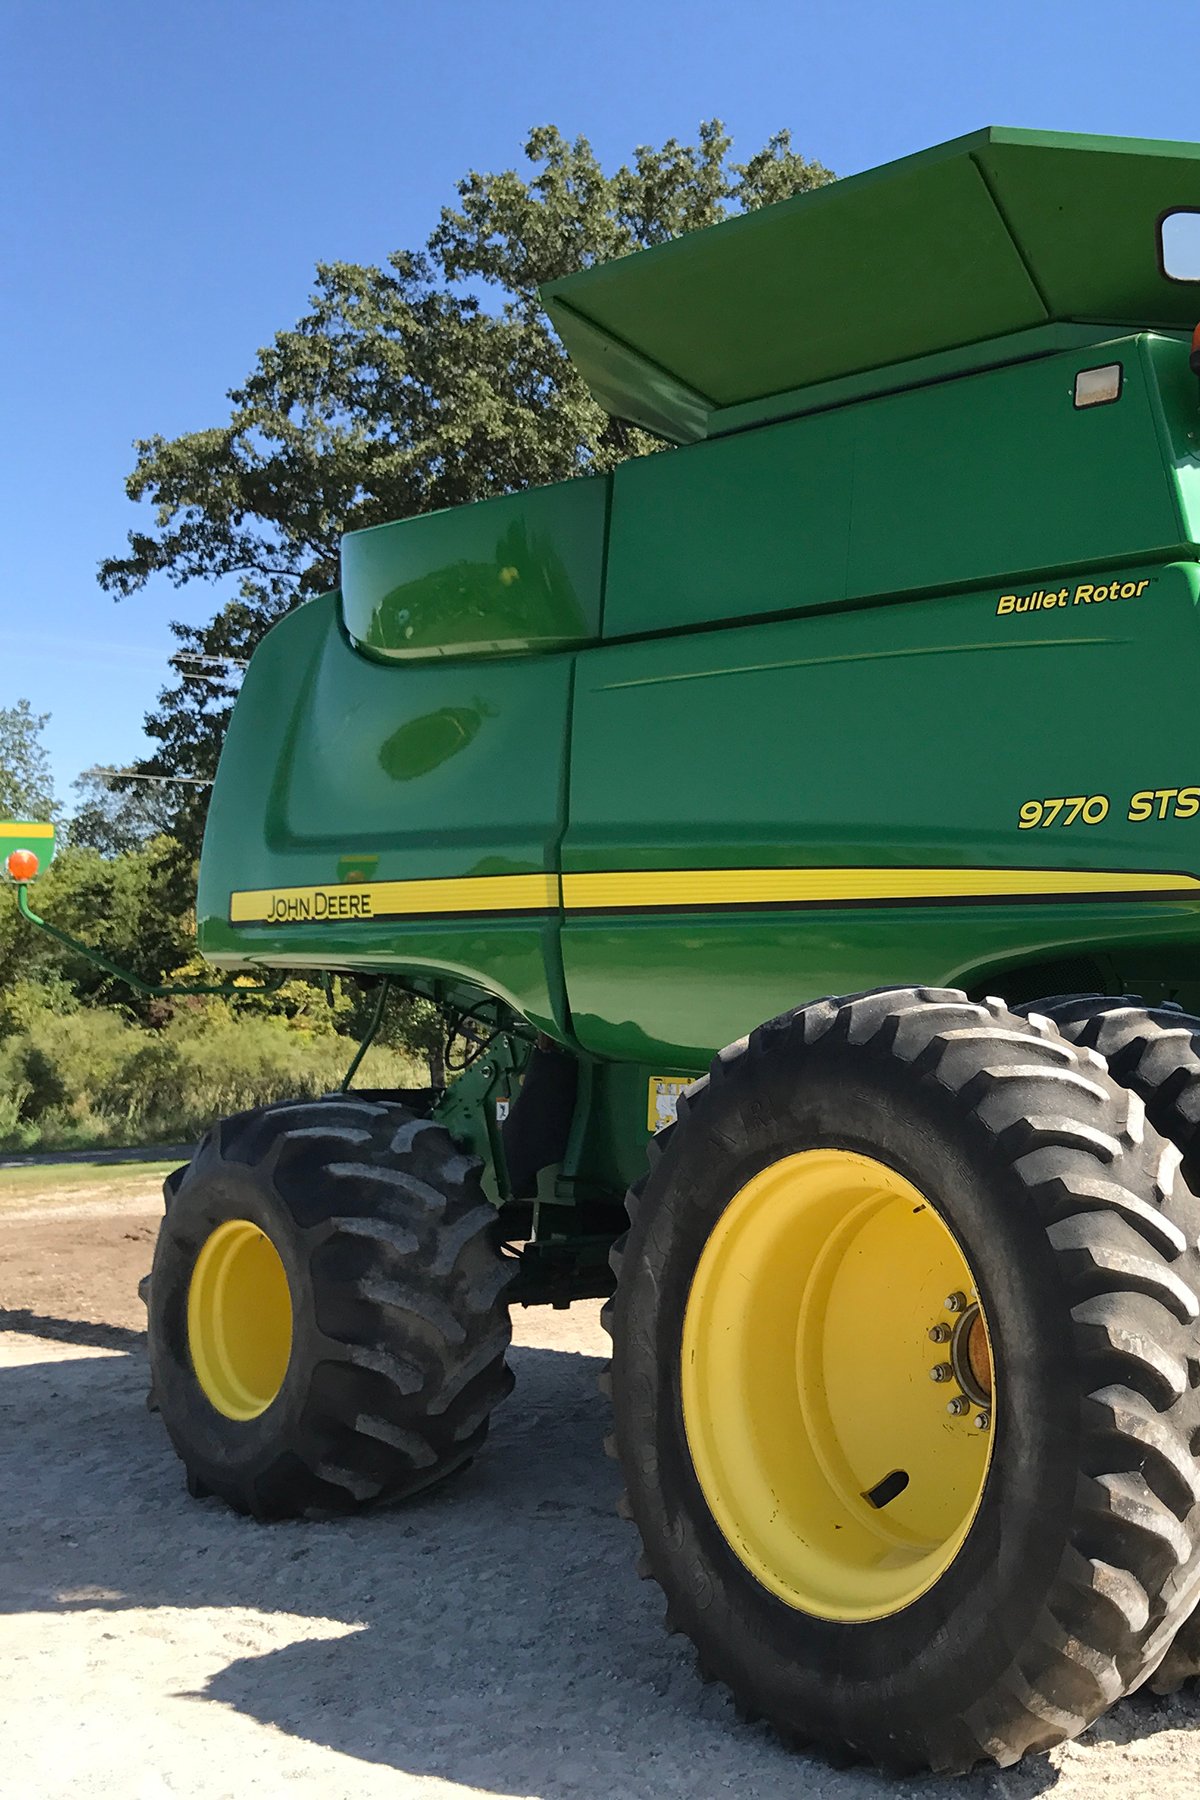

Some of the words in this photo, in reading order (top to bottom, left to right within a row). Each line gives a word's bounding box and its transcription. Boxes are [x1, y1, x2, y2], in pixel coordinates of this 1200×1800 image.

[996, 588, 1070, 616] Bullet
[1073, 579, 1150, 605] Rotor
[1017, 794, 1110, 830] 9770
[267, 895, 310, 918] JOHN
[314, 892, 372, 916] DEERE
